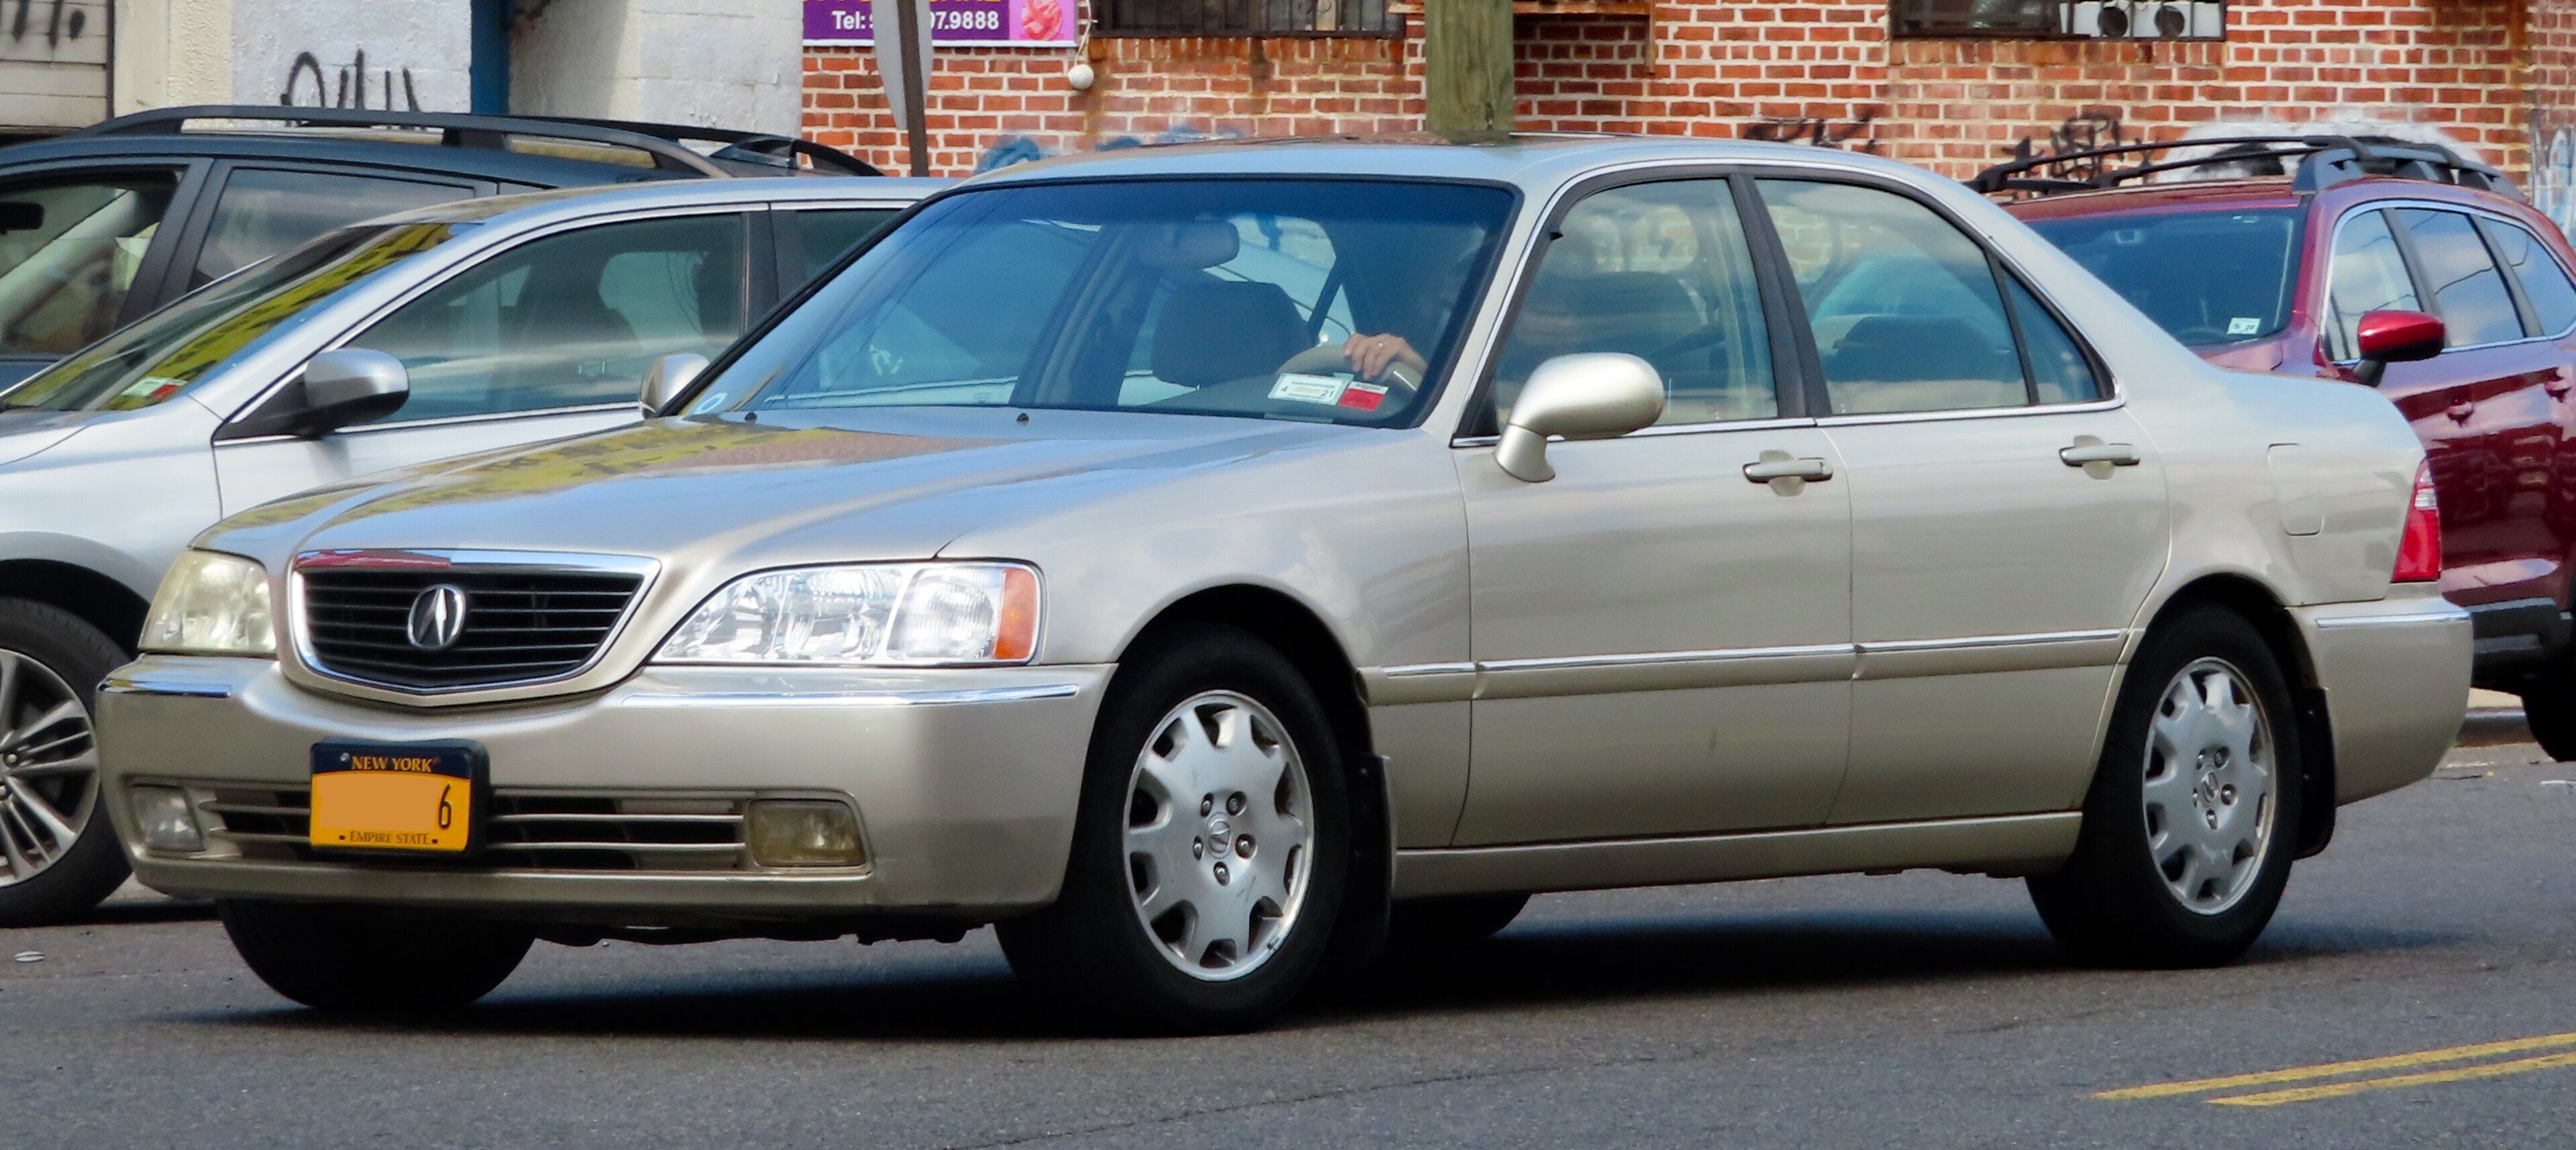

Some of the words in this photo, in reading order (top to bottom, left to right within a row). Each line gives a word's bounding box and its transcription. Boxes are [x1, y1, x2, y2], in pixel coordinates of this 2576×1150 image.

[831, 11, 865, 30] Tel:
[352, 756, 388, 770] NEW
[392, 757, 433, 772] YORK
[350, 831, 390, 843] EMPIRE
[396, 833, 429, 845] STATE
